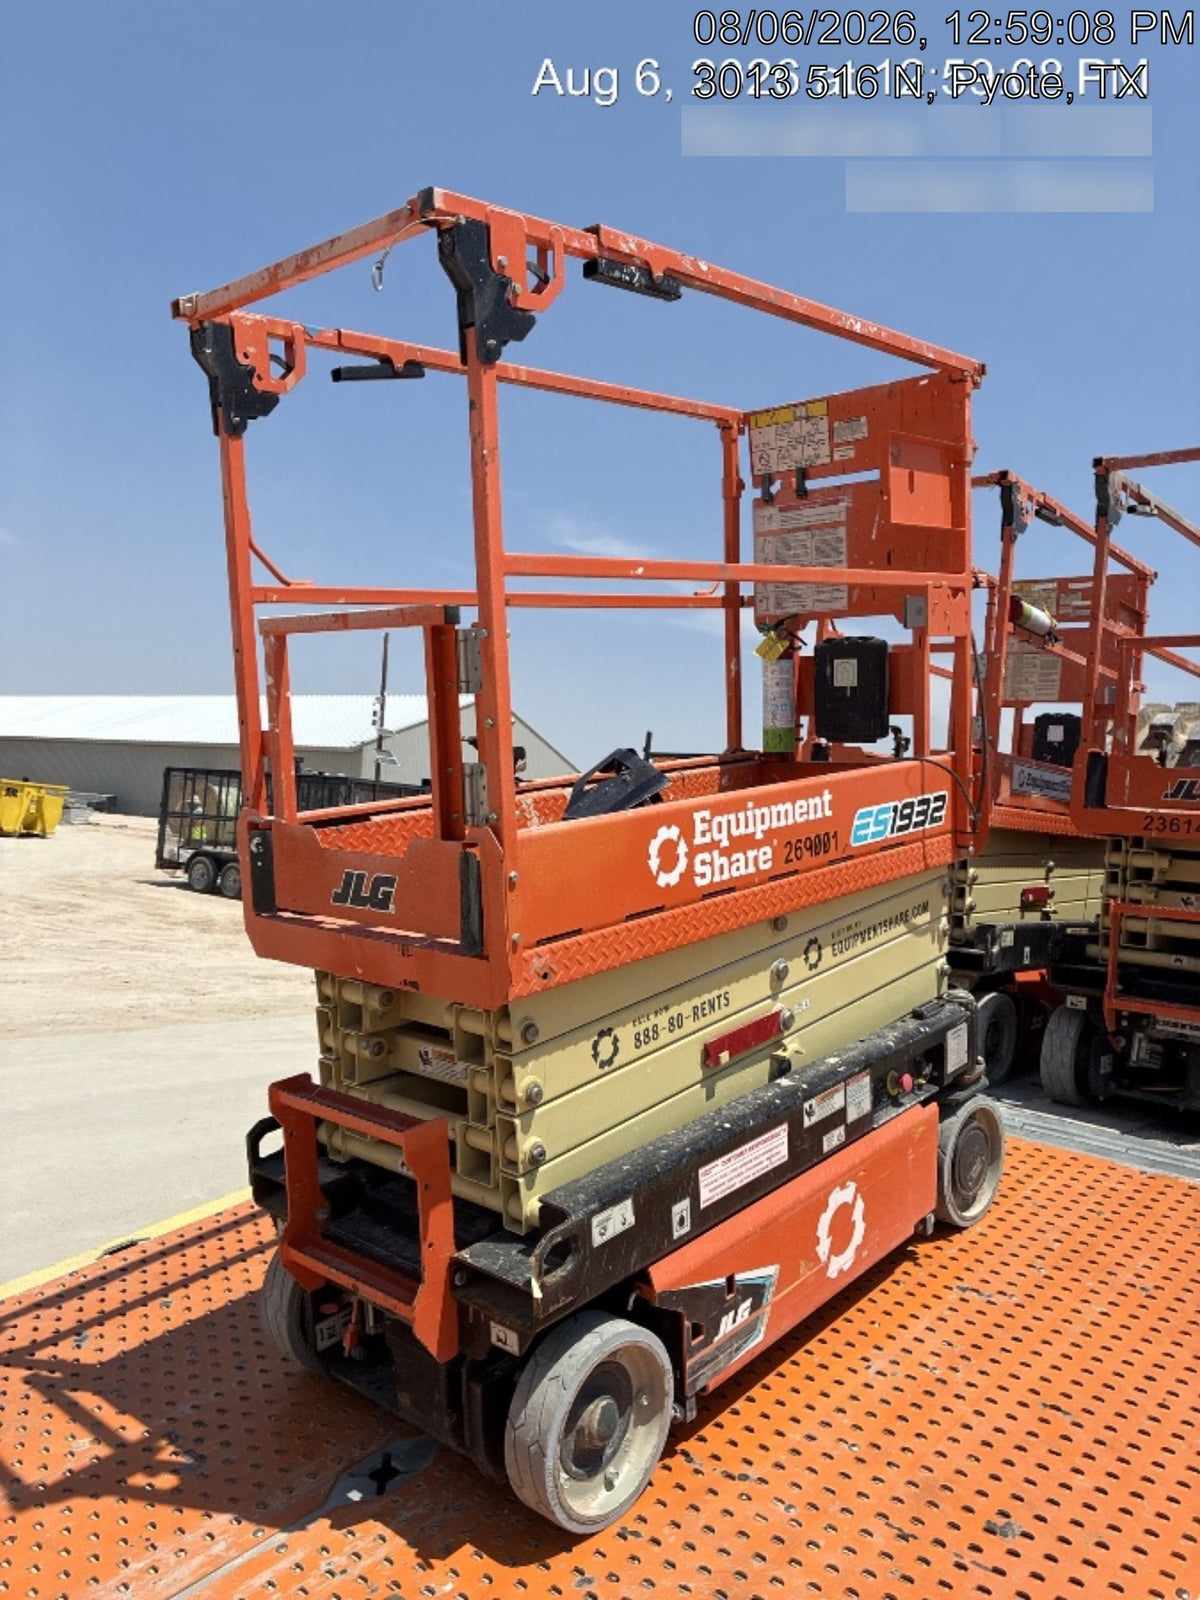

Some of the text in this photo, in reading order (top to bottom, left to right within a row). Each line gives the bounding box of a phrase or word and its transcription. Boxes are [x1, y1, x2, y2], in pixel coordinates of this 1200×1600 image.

[1161, 778, 1200, 802] JL
[693, 789, 833, 846] Equipment
[852, 790, 947, 846] ES1932
[693, 845, 774, 887] Share
[784, 830, 838, 864] 269001
[330, 869, 398, 913] JLG
[634, 991, 730, 1050] 888-80-RENTS
